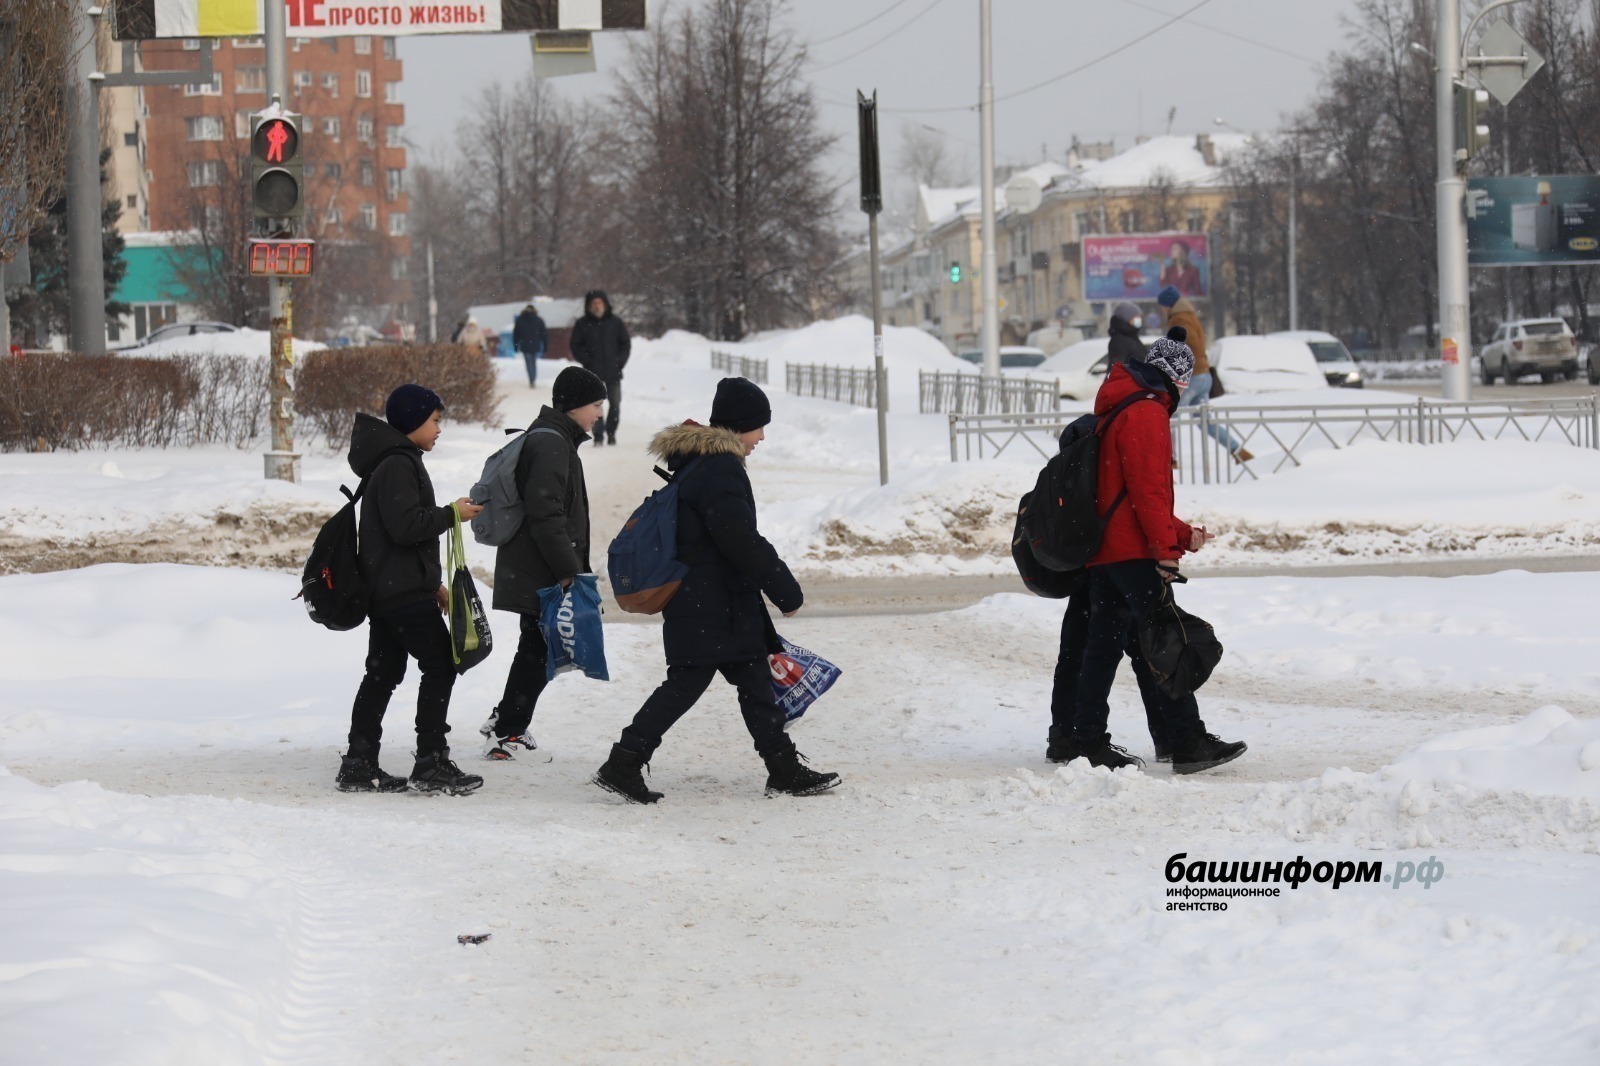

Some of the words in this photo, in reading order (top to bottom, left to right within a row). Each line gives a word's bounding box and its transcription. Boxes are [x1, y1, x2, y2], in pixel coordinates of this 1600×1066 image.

[329, 6, 402, 26] ПРОСТО
[409, 5, 485, 25] ЖИЗНЬ!
[807, 664, 823, 683] ЦЕНА
